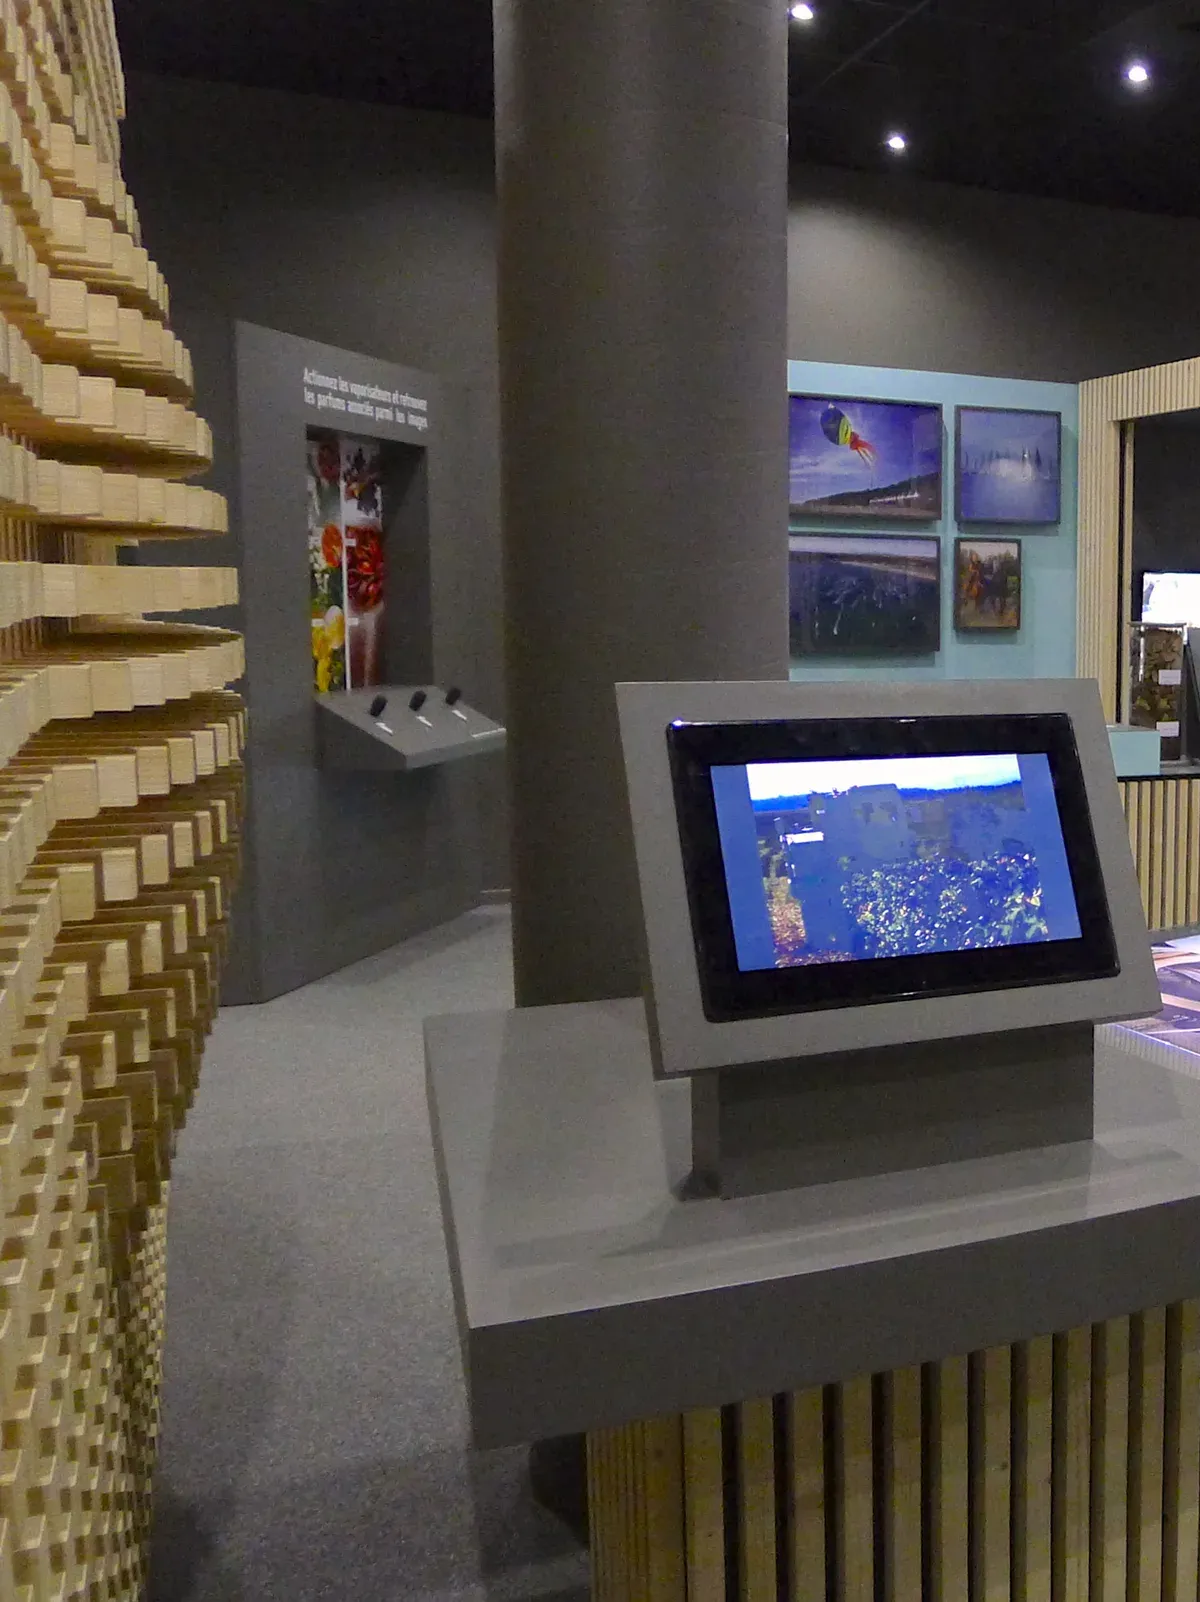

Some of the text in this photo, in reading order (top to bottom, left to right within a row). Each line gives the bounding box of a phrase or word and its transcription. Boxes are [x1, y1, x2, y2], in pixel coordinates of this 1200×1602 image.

[303, 366, 338, 391] Actionnez
[338, 375, 349, 393] les
[392, 389, 400, 405] et
[303, 386, 316, 405] les
[317, 391, 347, 410] parfums
